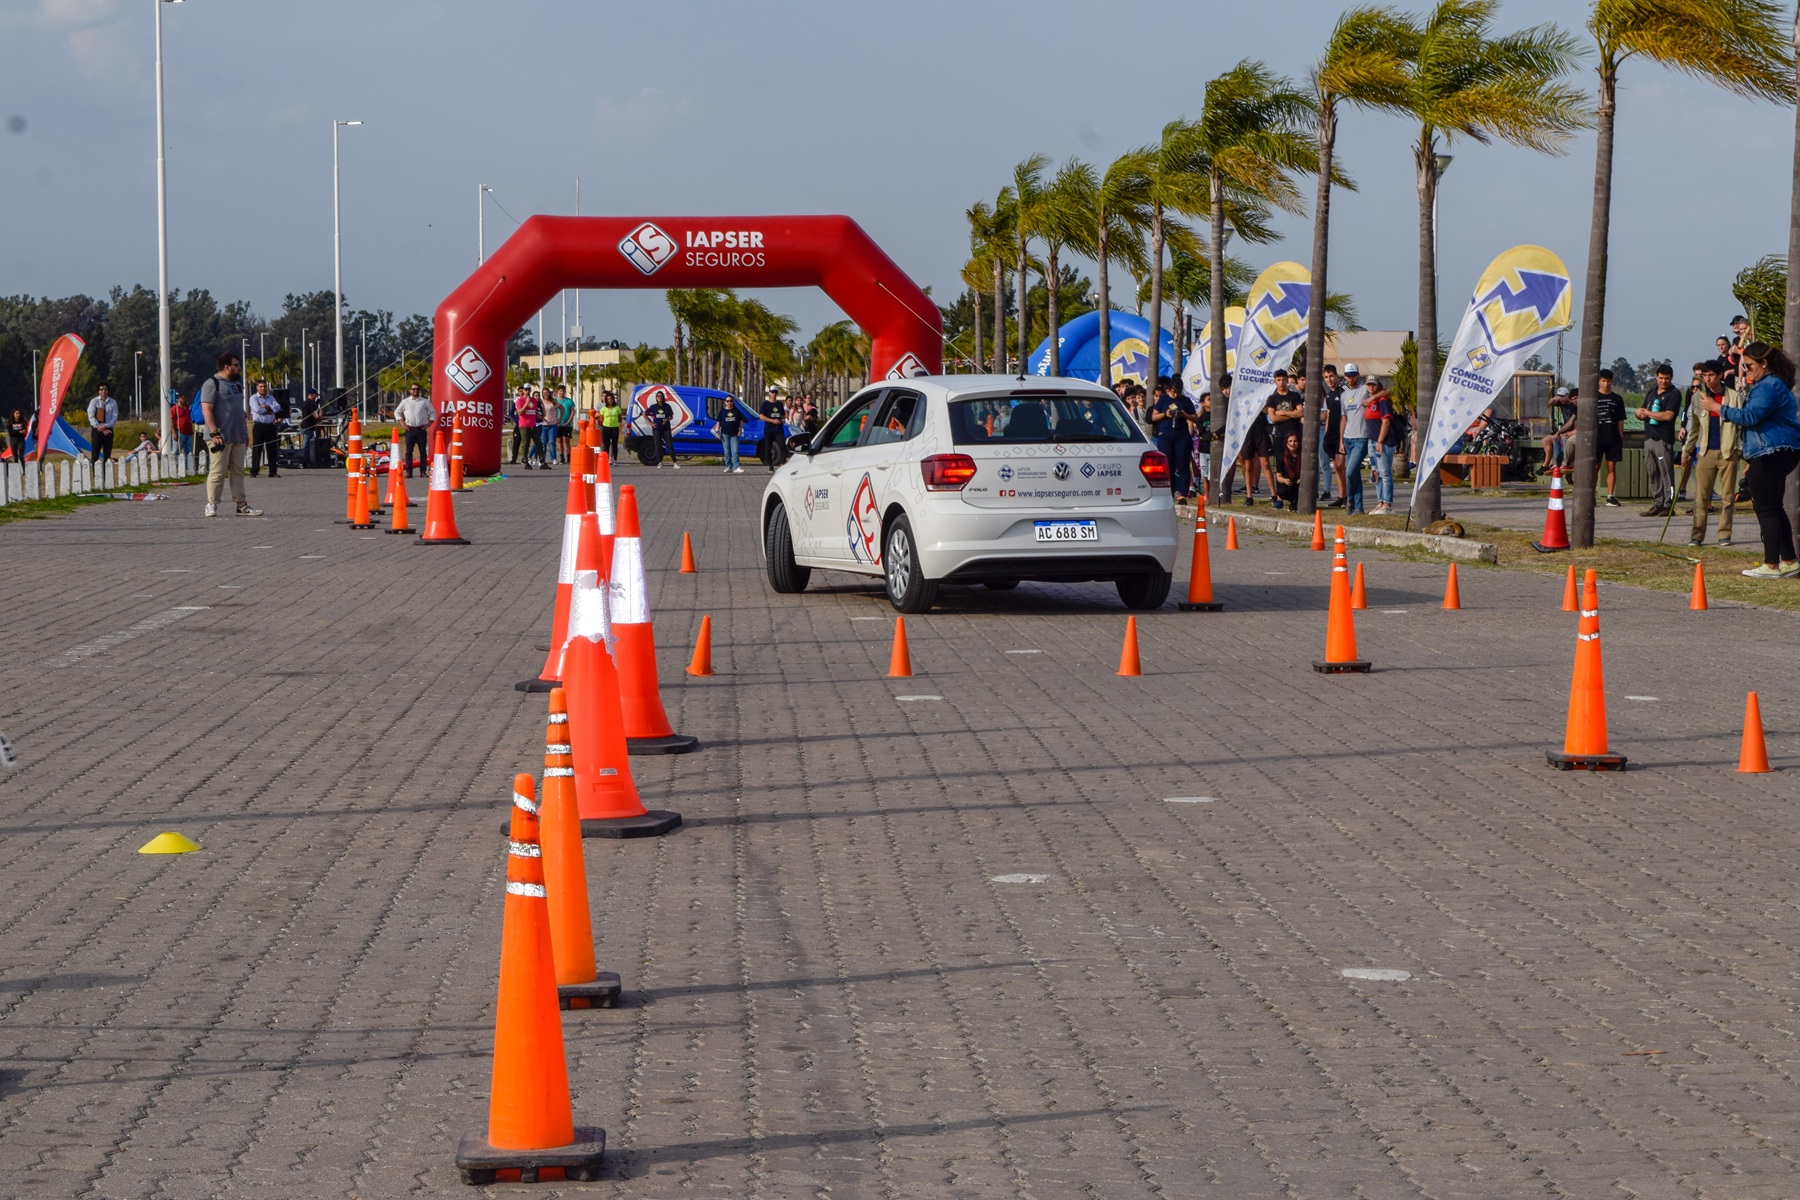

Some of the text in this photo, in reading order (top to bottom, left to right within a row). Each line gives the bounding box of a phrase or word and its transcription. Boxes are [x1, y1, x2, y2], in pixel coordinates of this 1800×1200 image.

[686, 231, 764, 248] IAPSER
[685, 252, 766, 267] SEGUROS
[1240, 367, 1273, 377] CONDUC
[49, 357, 62, 415] Gualeguay
[1448, 374, 1493, 395] TU CURSO
[441, 400, 494, 416] IAPSER
[440, 416, 494, 429] SEUROS
[815, 489, 829, 499] IAPSER
[1017, 488, 1102, 499] www.iapserseguros.com.ar
[1038, 526, 1095, 539] AC 688 SM
